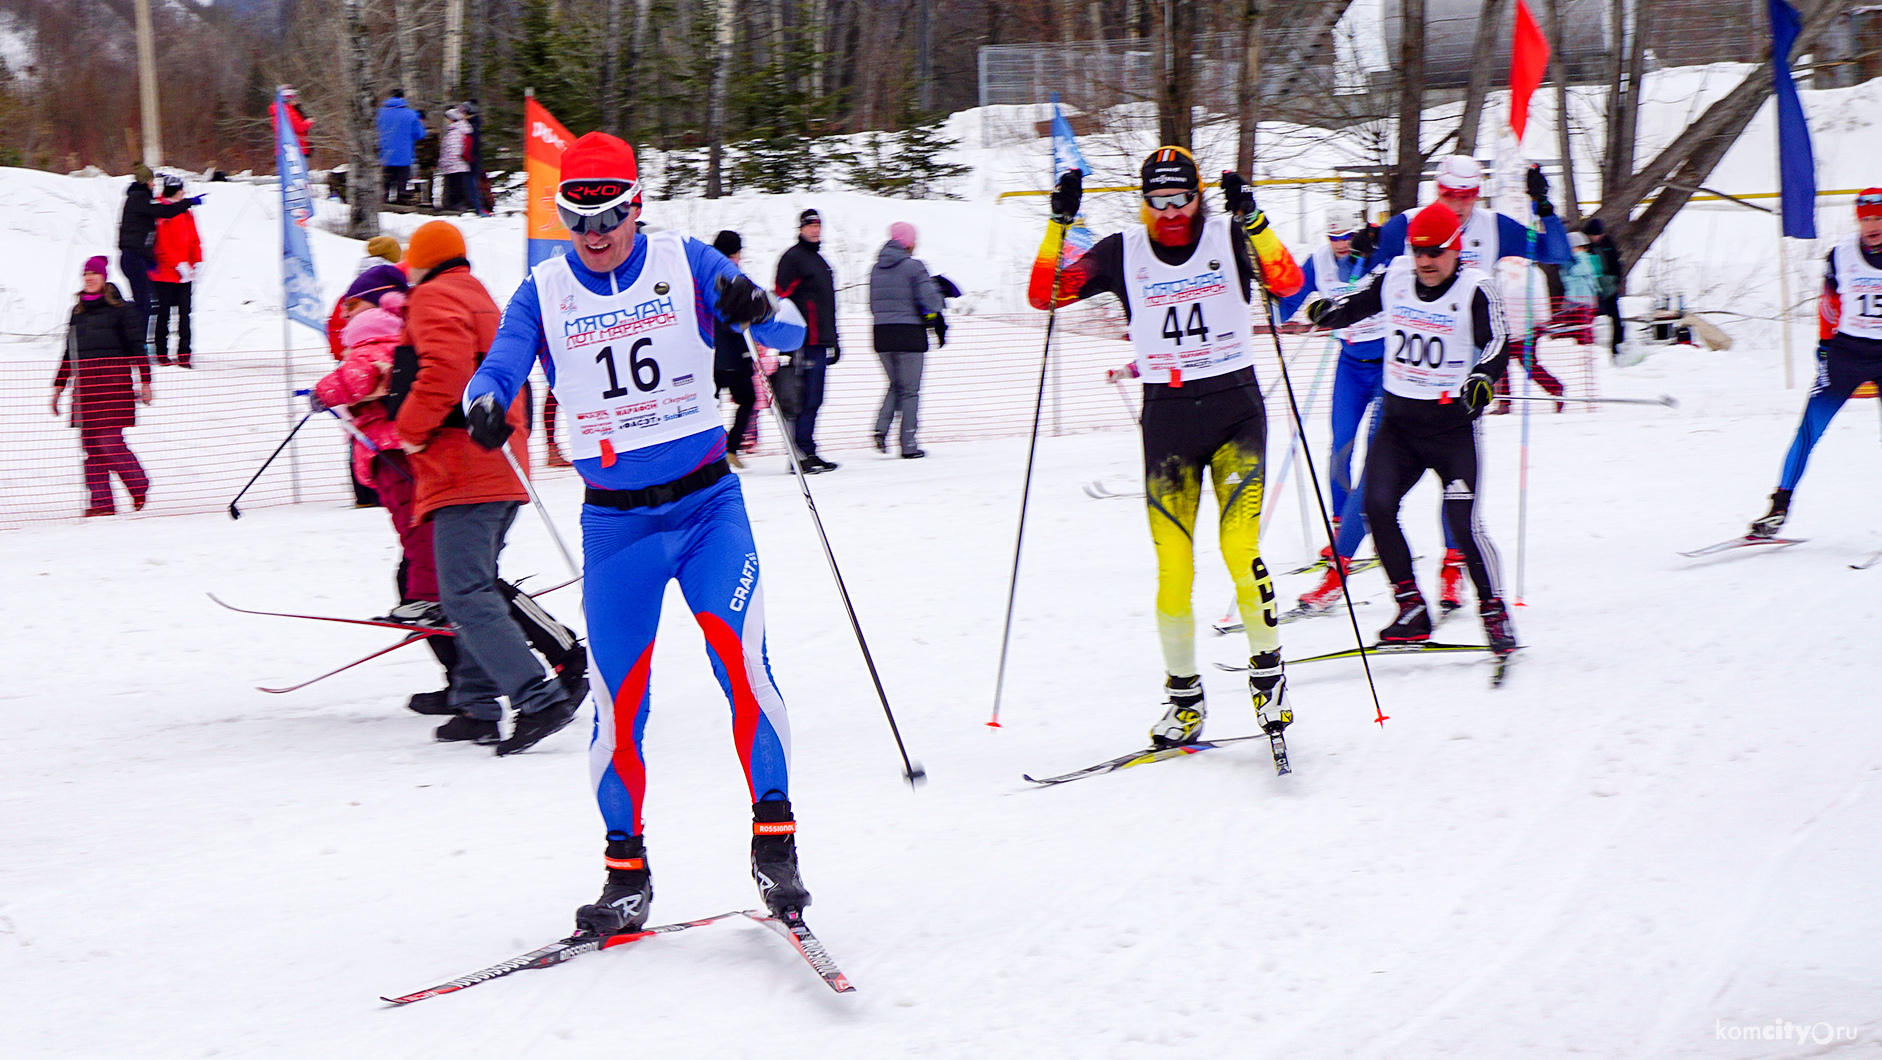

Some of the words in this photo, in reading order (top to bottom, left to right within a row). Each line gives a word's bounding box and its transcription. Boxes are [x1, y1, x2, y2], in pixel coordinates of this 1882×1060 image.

[1162, 302, 1209, 346] 44
[595, 337, 661, 400] 16
[1394, 329, 1445, 369] 200
[729, 560, 756, 612] CRAFT
[1252, 556, 1278, 628] CEP
[759, 823, 795, 832] ROSSIGNOL
